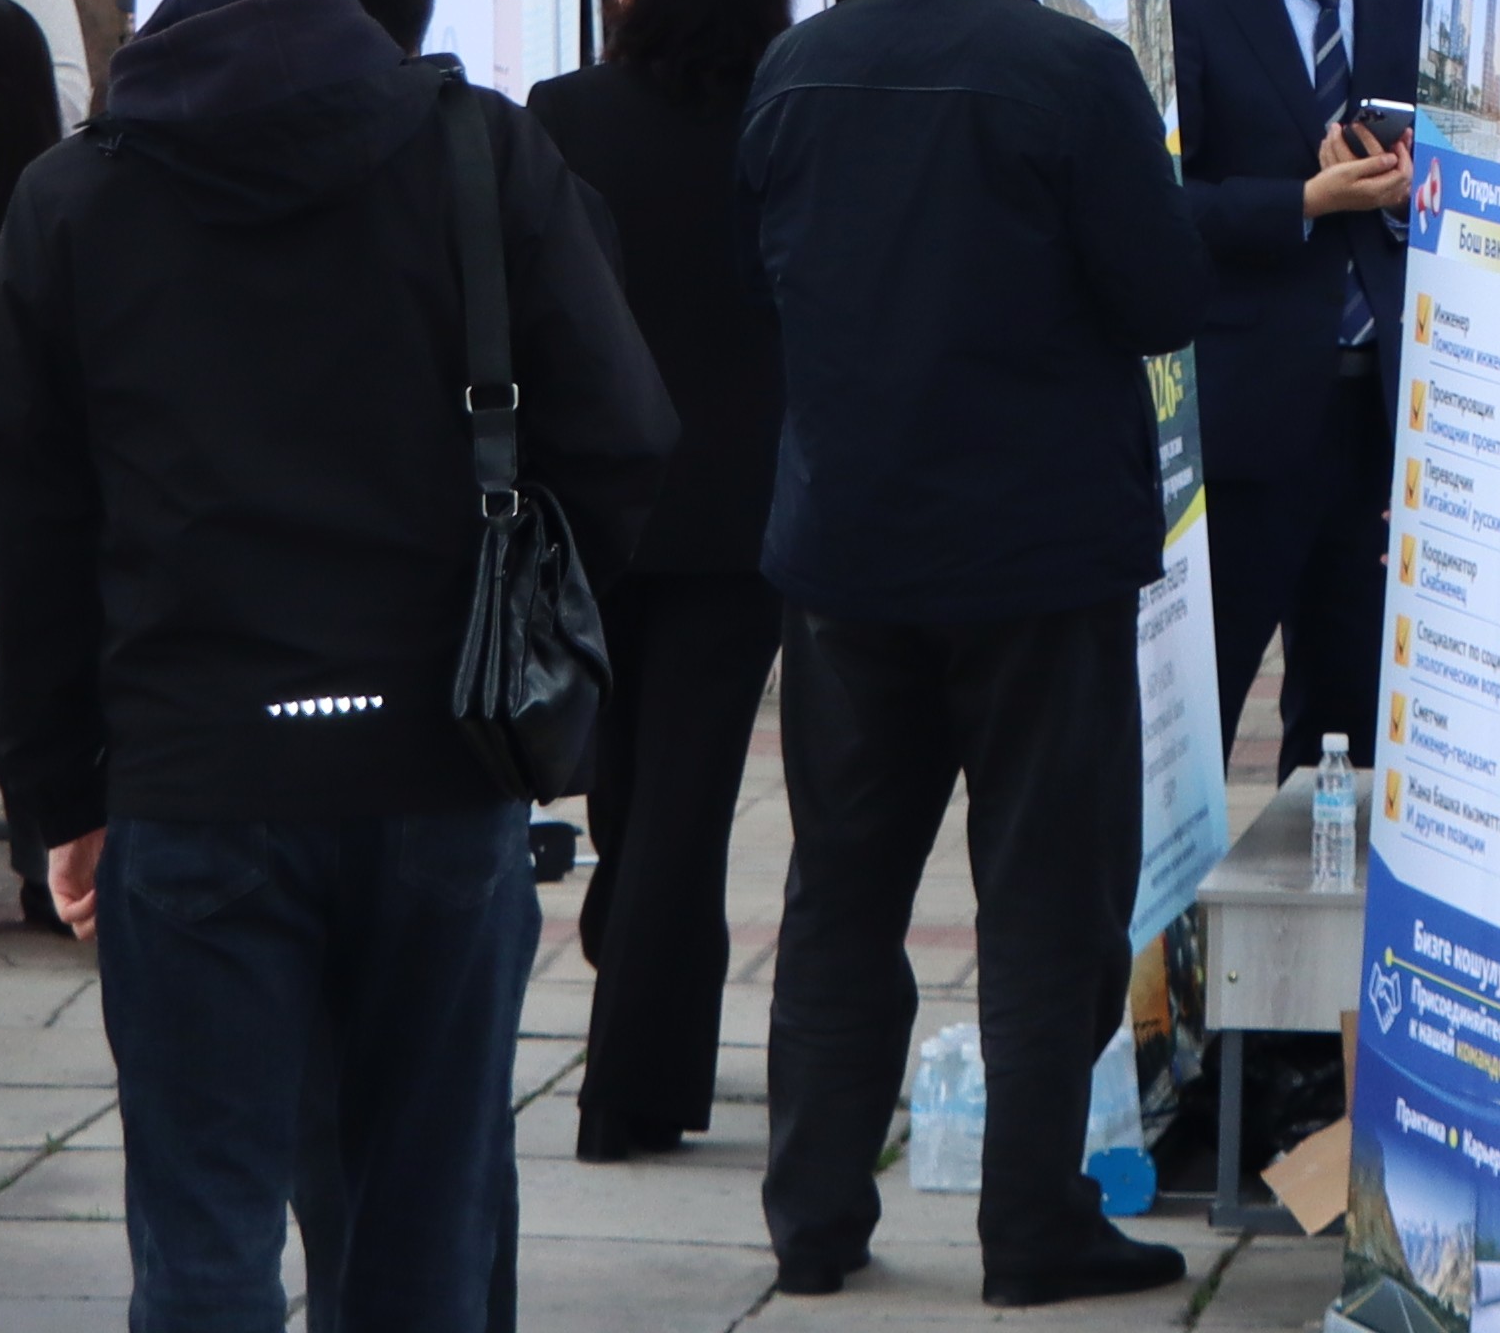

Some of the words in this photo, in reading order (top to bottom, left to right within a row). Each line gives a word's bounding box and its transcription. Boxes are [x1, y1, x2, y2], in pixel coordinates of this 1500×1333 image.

[1459, 223, 1482, 255] Бош
[1433, 302, 1470, 339] Инженер
[1431, 330, 1475, 364] Помощник
[1429, 379, 1495, 421] Проектировщик
[1426, 412, 1470, 445] Помощник
[1424, 457, 1474, 493] Переводчик
[1421, 540, 1478, 584] Координатор
[1416, 619, 1467, 655] Специалист
[1468, 642, 1480, 662] по
[1412, 697, 1449, 732] Сметчик
[1410, 723, 1498, 776] Инженер-геодезист
[1407, 775, 1432, 804] Жана
[1433, 785, 1460, 816] башка
[1415, 809, 1446, 839] другие
[1446, 821, 1486, 855] позиции
[1413, 918, 1453, 966] Бизге
[1418, 1019, 1455, 1058] нашей
[1395, 1096, 1447, 1134] Практика
